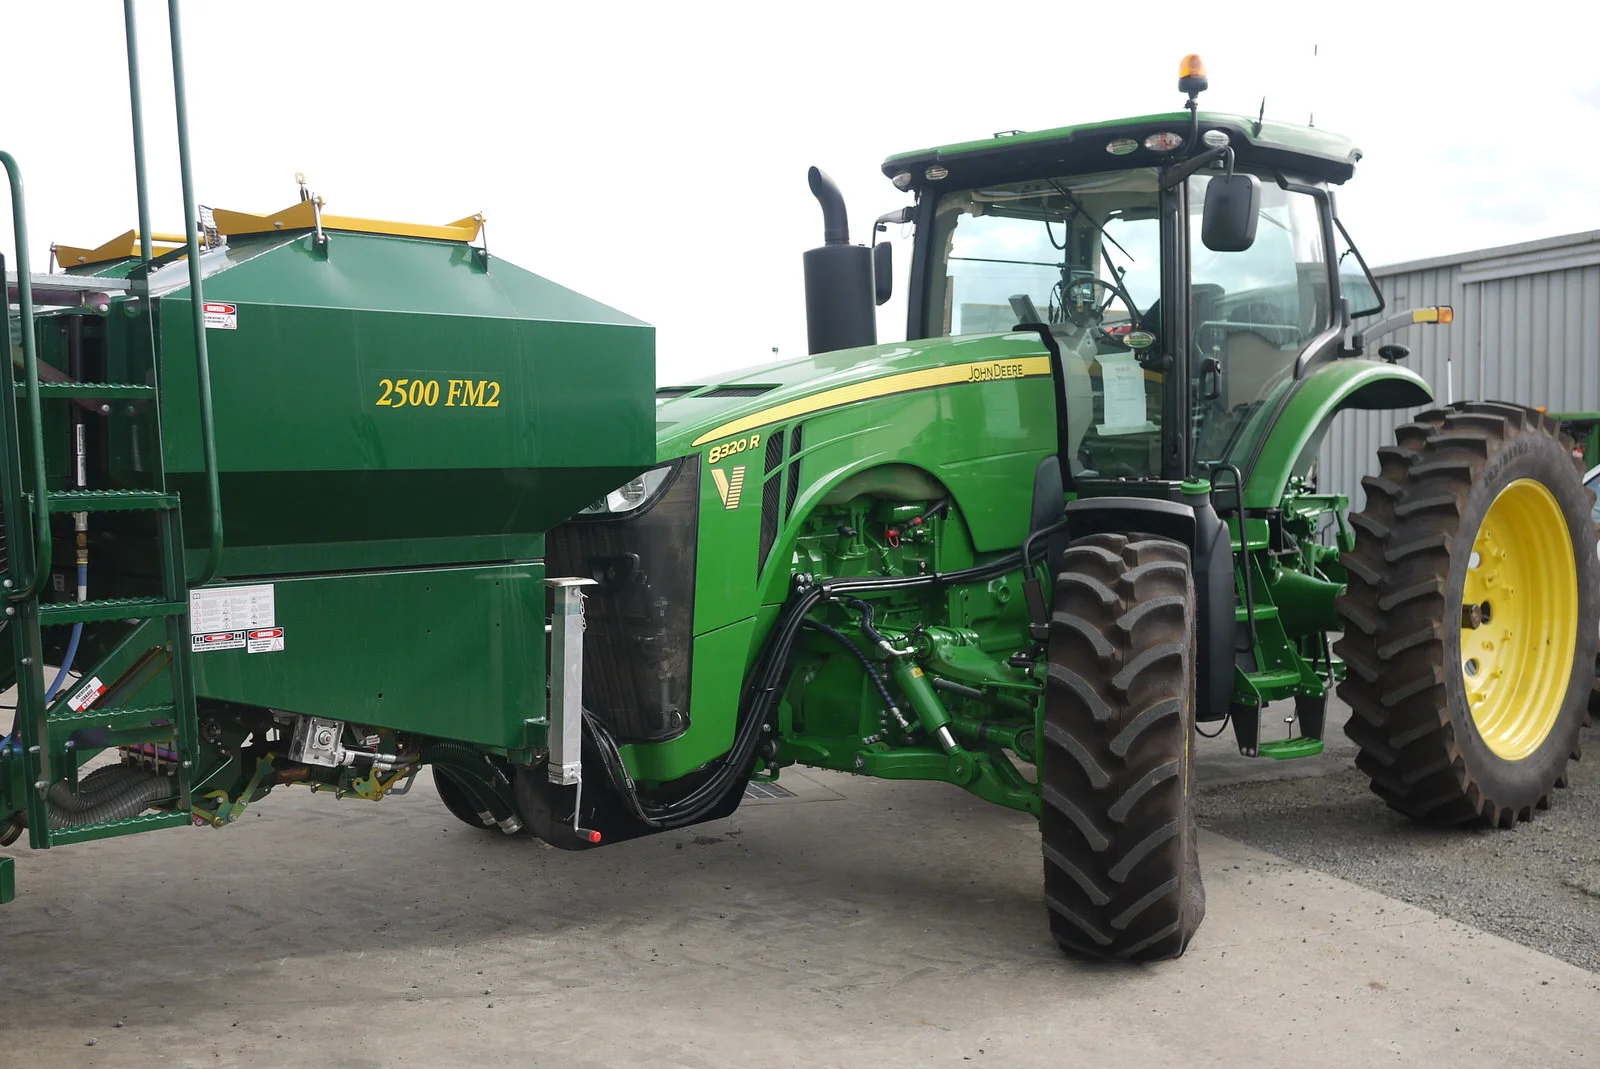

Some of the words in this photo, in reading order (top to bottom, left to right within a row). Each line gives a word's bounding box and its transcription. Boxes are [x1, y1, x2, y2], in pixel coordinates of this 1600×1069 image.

[376, 379, 440, 408] 2500
[445, 379, 500, 407] FM2
[708, 438, 747, 464] 8320
[749, 434, 760, 450] R
